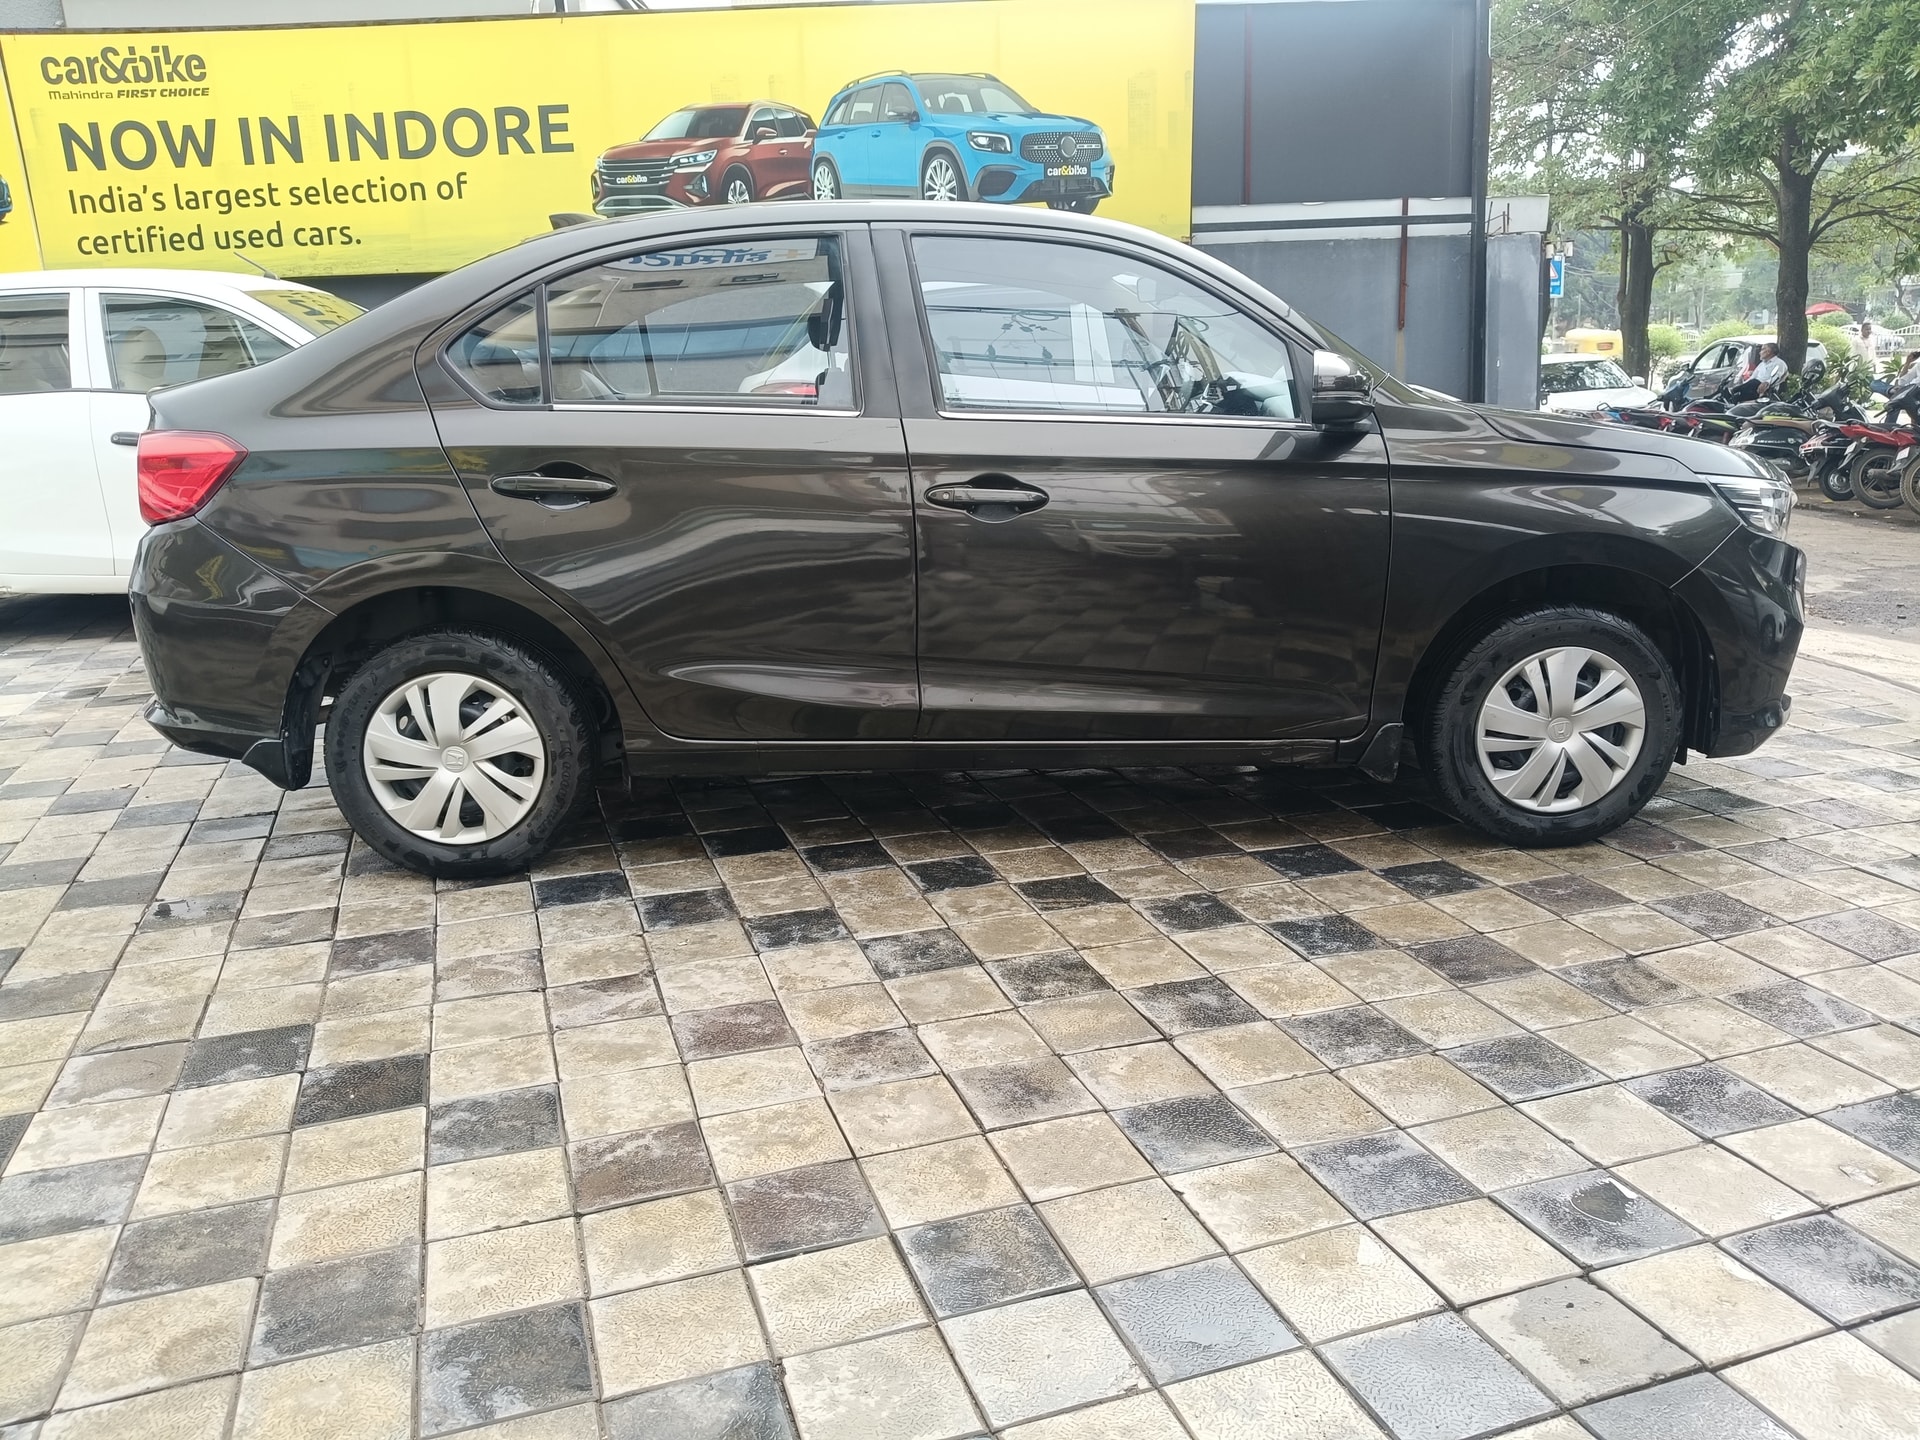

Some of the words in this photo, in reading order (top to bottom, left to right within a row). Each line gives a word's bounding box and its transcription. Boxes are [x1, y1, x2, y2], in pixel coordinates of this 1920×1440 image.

[40, 45, 207, 86] car&bike
[48, 90, 114, 101] Mahindra
[117, 89, 157, 99] FIRST
[160, 87, 210, 97] CHOICE
[58, 118, 216, 172] NOW
[238, 115, 304, 166] IN
[323, 104, 575, 162] INDORE
[1047, 164, 1088, 177] car&bike
[68, 184, 167, 215] India's
[173, 183, 281, 215] largest
[288, 176, 427, 206] selection
[436, 171, 468, 200] of
[77, 223, 205, 256] certified
[214, 220, 284, 250] used
[293, 224, 362, 247] cars.
